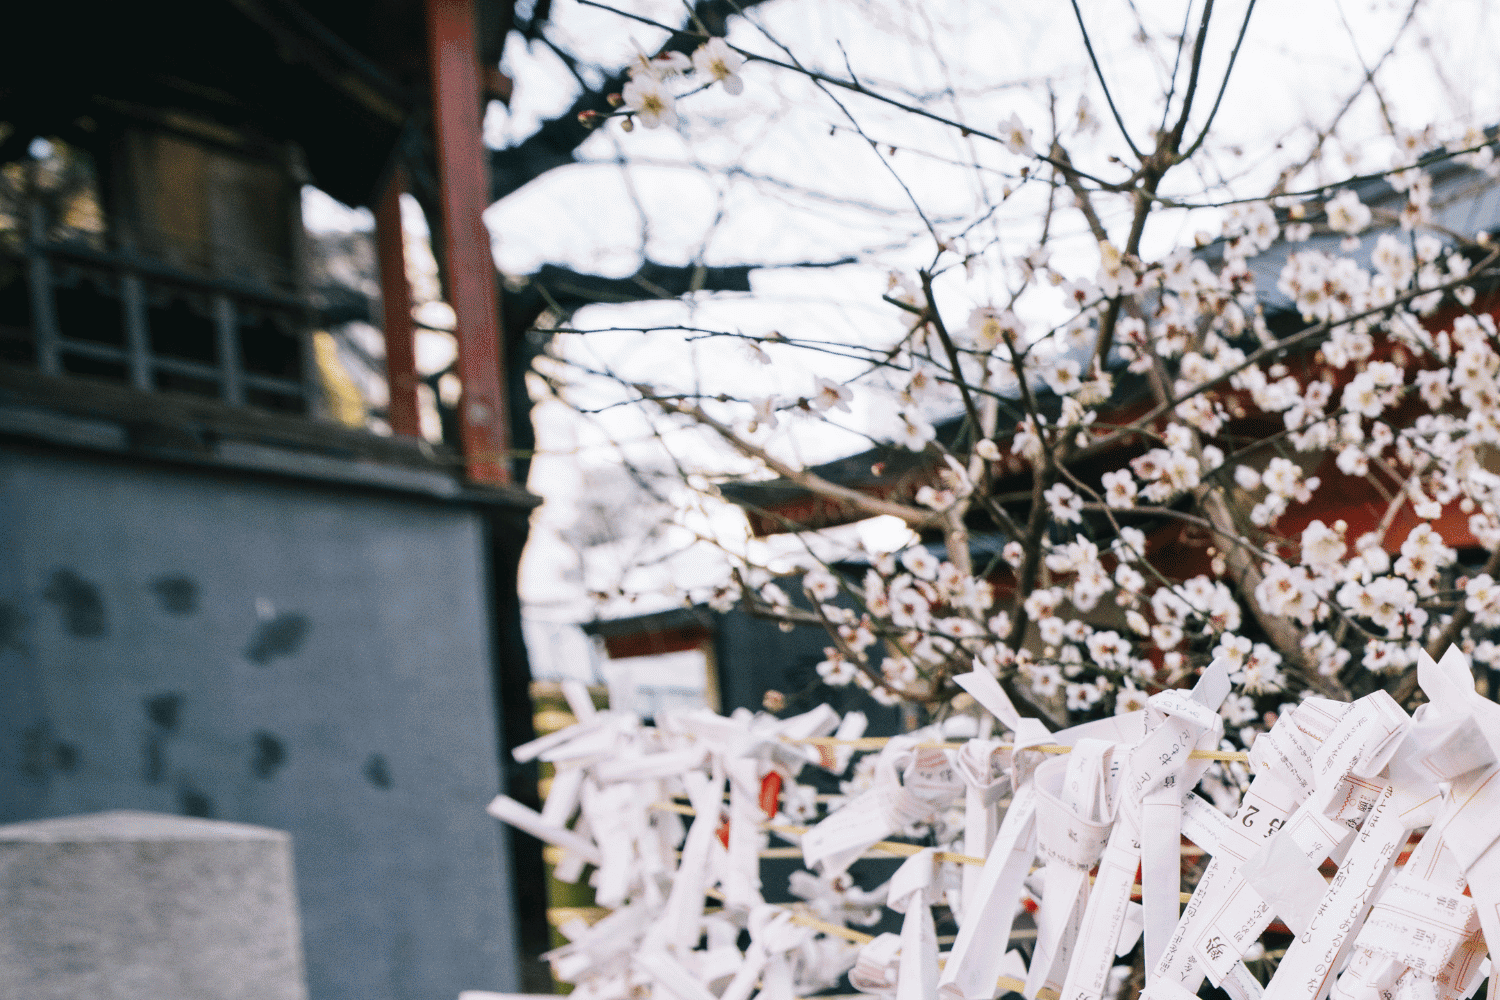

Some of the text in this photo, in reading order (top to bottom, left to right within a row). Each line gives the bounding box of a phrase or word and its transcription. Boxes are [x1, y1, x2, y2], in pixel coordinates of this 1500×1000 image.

[1299, 855, 1356, 947] 大和だましひ
